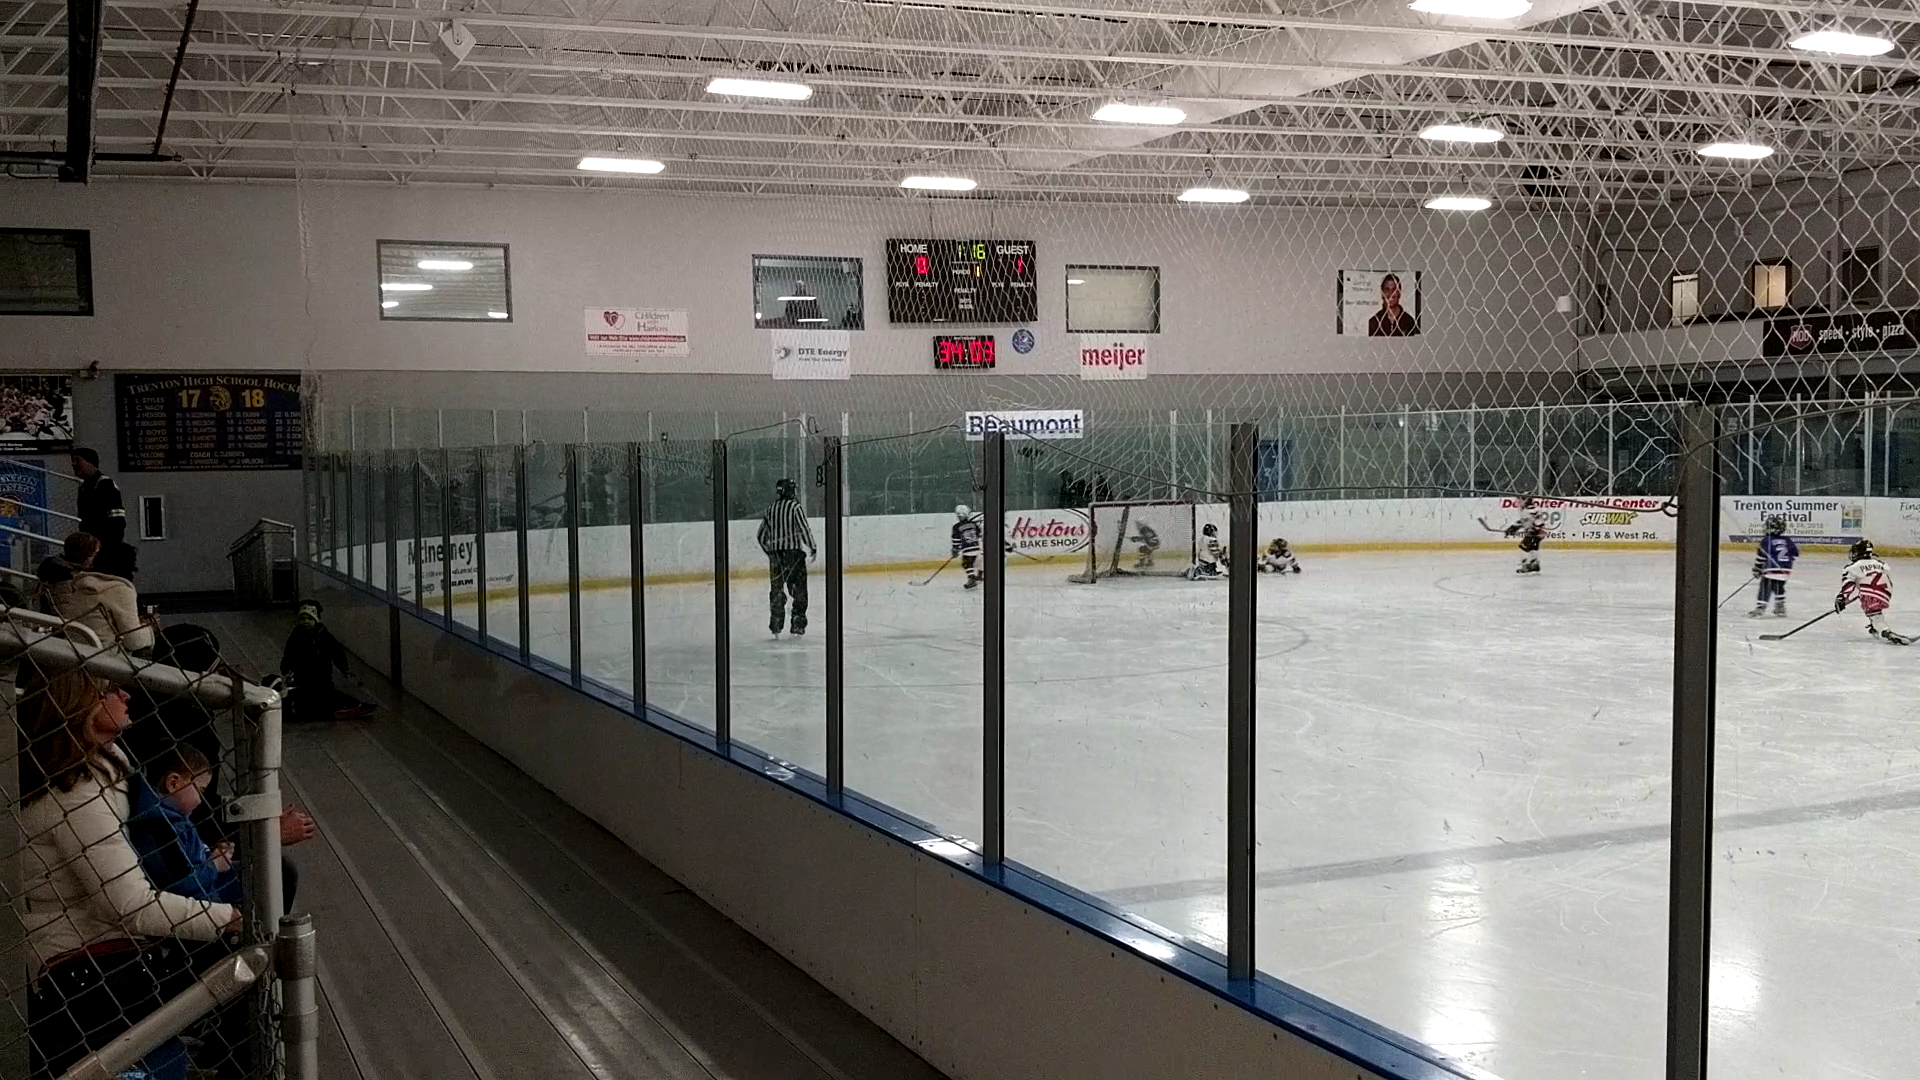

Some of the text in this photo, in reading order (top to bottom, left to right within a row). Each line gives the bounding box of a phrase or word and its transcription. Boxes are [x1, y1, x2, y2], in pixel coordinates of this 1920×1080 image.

[900, 244, 928, 253] HOME
[996, 245, 1029, 254] GUEST
[1818, 325, 1844, 344] speed
[1851, 323, 1873, 341] style
[1882, 321, 1905, 339] pizza
[798, 347, 848, 358] DTE Energy
[1082, 342, 1145, 370] meijer
[183, 376, 213, 387] HIGH
[216, 375, 261, 387] SCHOOL
[263, 377, 300, 393] HOCK
[178, 388, 265, 408] 17 18
[968, 414, 1081, 436] Beaumont
[1502, 499, 1564, 509] Deoiter
[1612, 498, 1660, 509] Center
[1733, 500, 1839, 511] Trenton Summer
[1580, 511, 1639, 526] SUBWAY
[1760, 510, 1813, 523] Festival
[1011, 516, 1085, 539] Hortons
[1020, 539, 1048, 548] BAKE
[1050, 538, 1079, 547] SHOP
[1582, 531, 1601, 539] I-75
[1603, 531, 1611, 539] &
[1613, 531, 1639, 539] West
[1642, 531, 1659, 540] Rd.
[1775, 544, 1790, 562] 2
